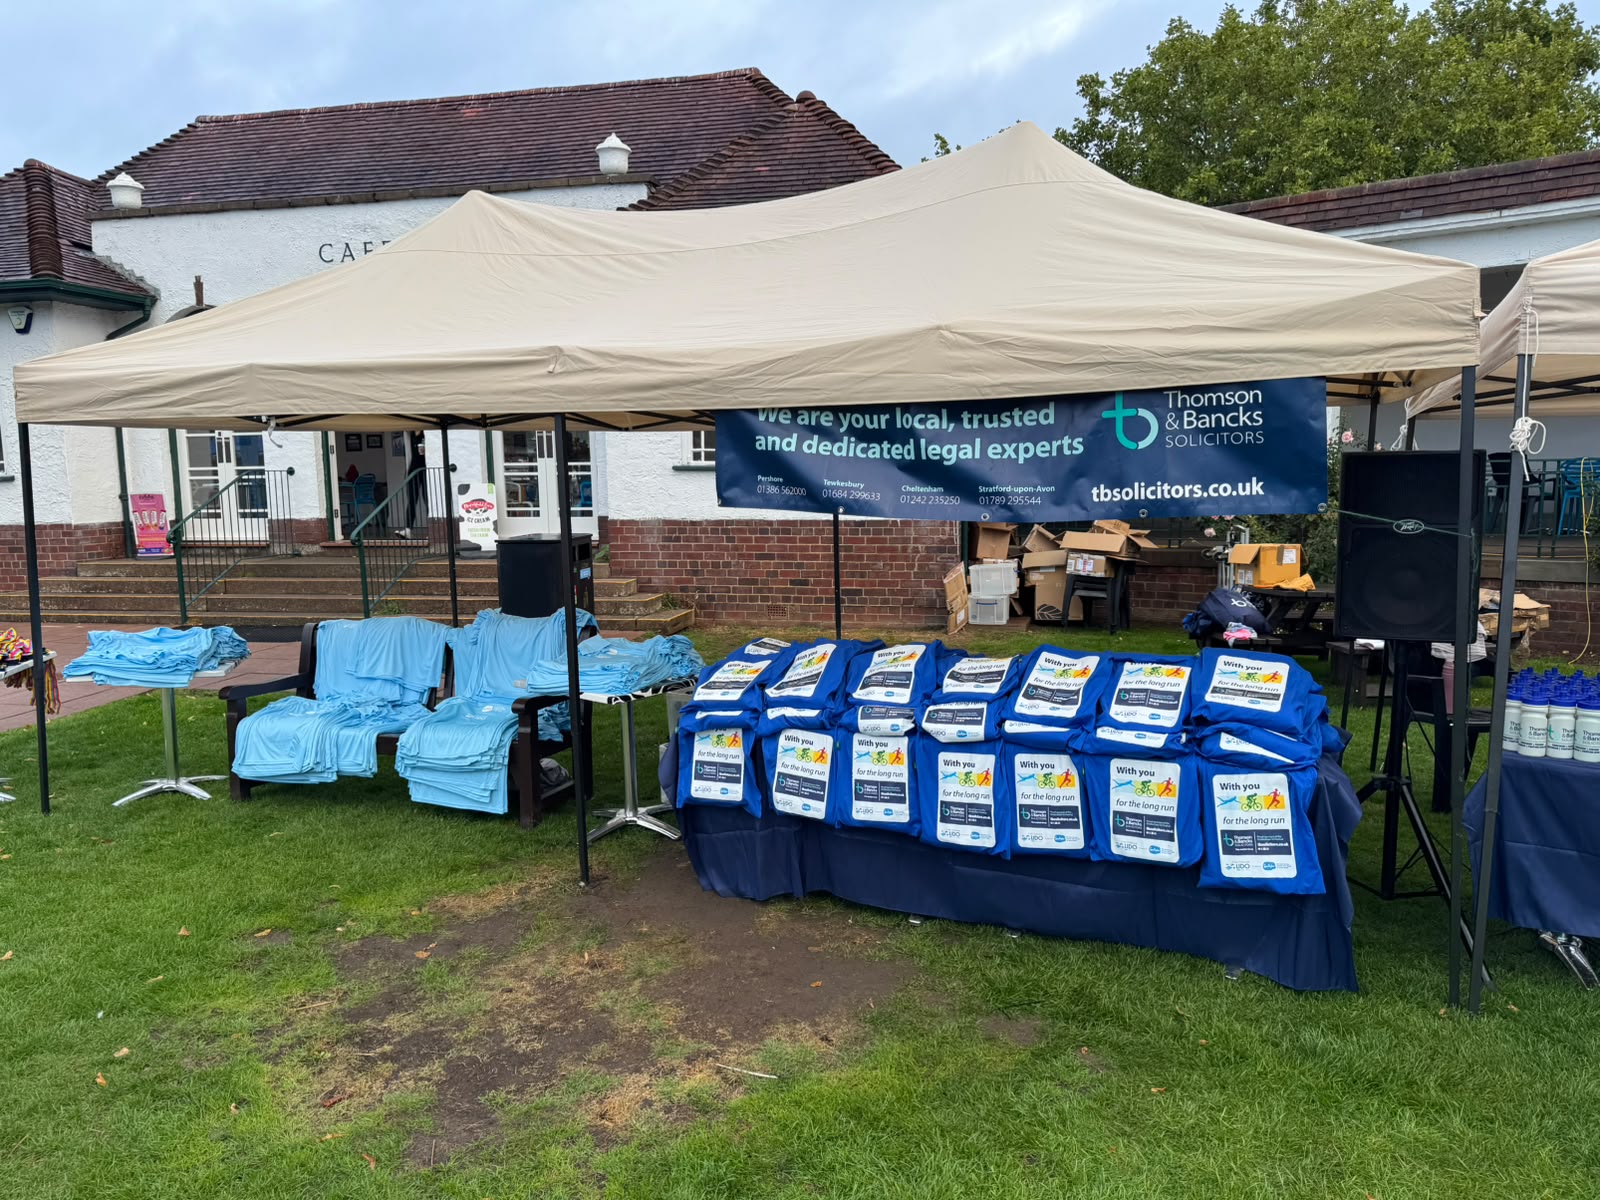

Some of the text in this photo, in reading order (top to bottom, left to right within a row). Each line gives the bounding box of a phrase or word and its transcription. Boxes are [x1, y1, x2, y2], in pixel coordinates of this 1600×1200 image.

[318, 240, 392, 263] CAF
[1164, 390, 1262, 408] Thomson
[758, 402, 1055, 433] We are your local, trusted
[1166, 406, 1263, 430] & Bancks
[1165, 431, 1264, 448] SOLICITORS
[756, 433, 1084, 466] and dedicated legal experts
[757, 475, 783, 483] Pershore
[823, 479, 864, 490] Tewkesbury
[901, 485, 944, 493] Cheltenham
[978, 485, 1055, 494] Stratford-upon-Avon
[1092, 477, 1265, 502] tbsolicitors.co.uk
[757, 485, 807, 496] 01386 562000
[822, 488, 881, 501] 01684 299633
[900, 495, 960, 505] 01242 235250
[979, 496, 1041, 505] 01789 295544
[1044, 657, 1062, 666] With
[1149, 680, 1166, 688] long
[784, 735, 814, 746] With you
[858, 739, 874, 747] With
[943, 759, 960, 767] With
[790, 763, 800, 772] the
[800, 765, 814, 775] long
[877, 769, 891, 778] long
[1116, 766, 1137, 775] With
[1242, 783, 1260, 792] you
[942, 789, 952, 797] for
[952, 790, 963, 798] the
[964, 791, 979, 800] long
[1020, 792, 1031, 800] for
[1045, 793, 1060, 802] long
[1116, 798, 1127, 807] for
[1128, 800, 1141, 808] the
[1142, 802, 1159, 812] long
[1223, 816, 1234, 825] for
[1235, 816, 1249, 824] the
[1250, 816, 1269, 826] long
